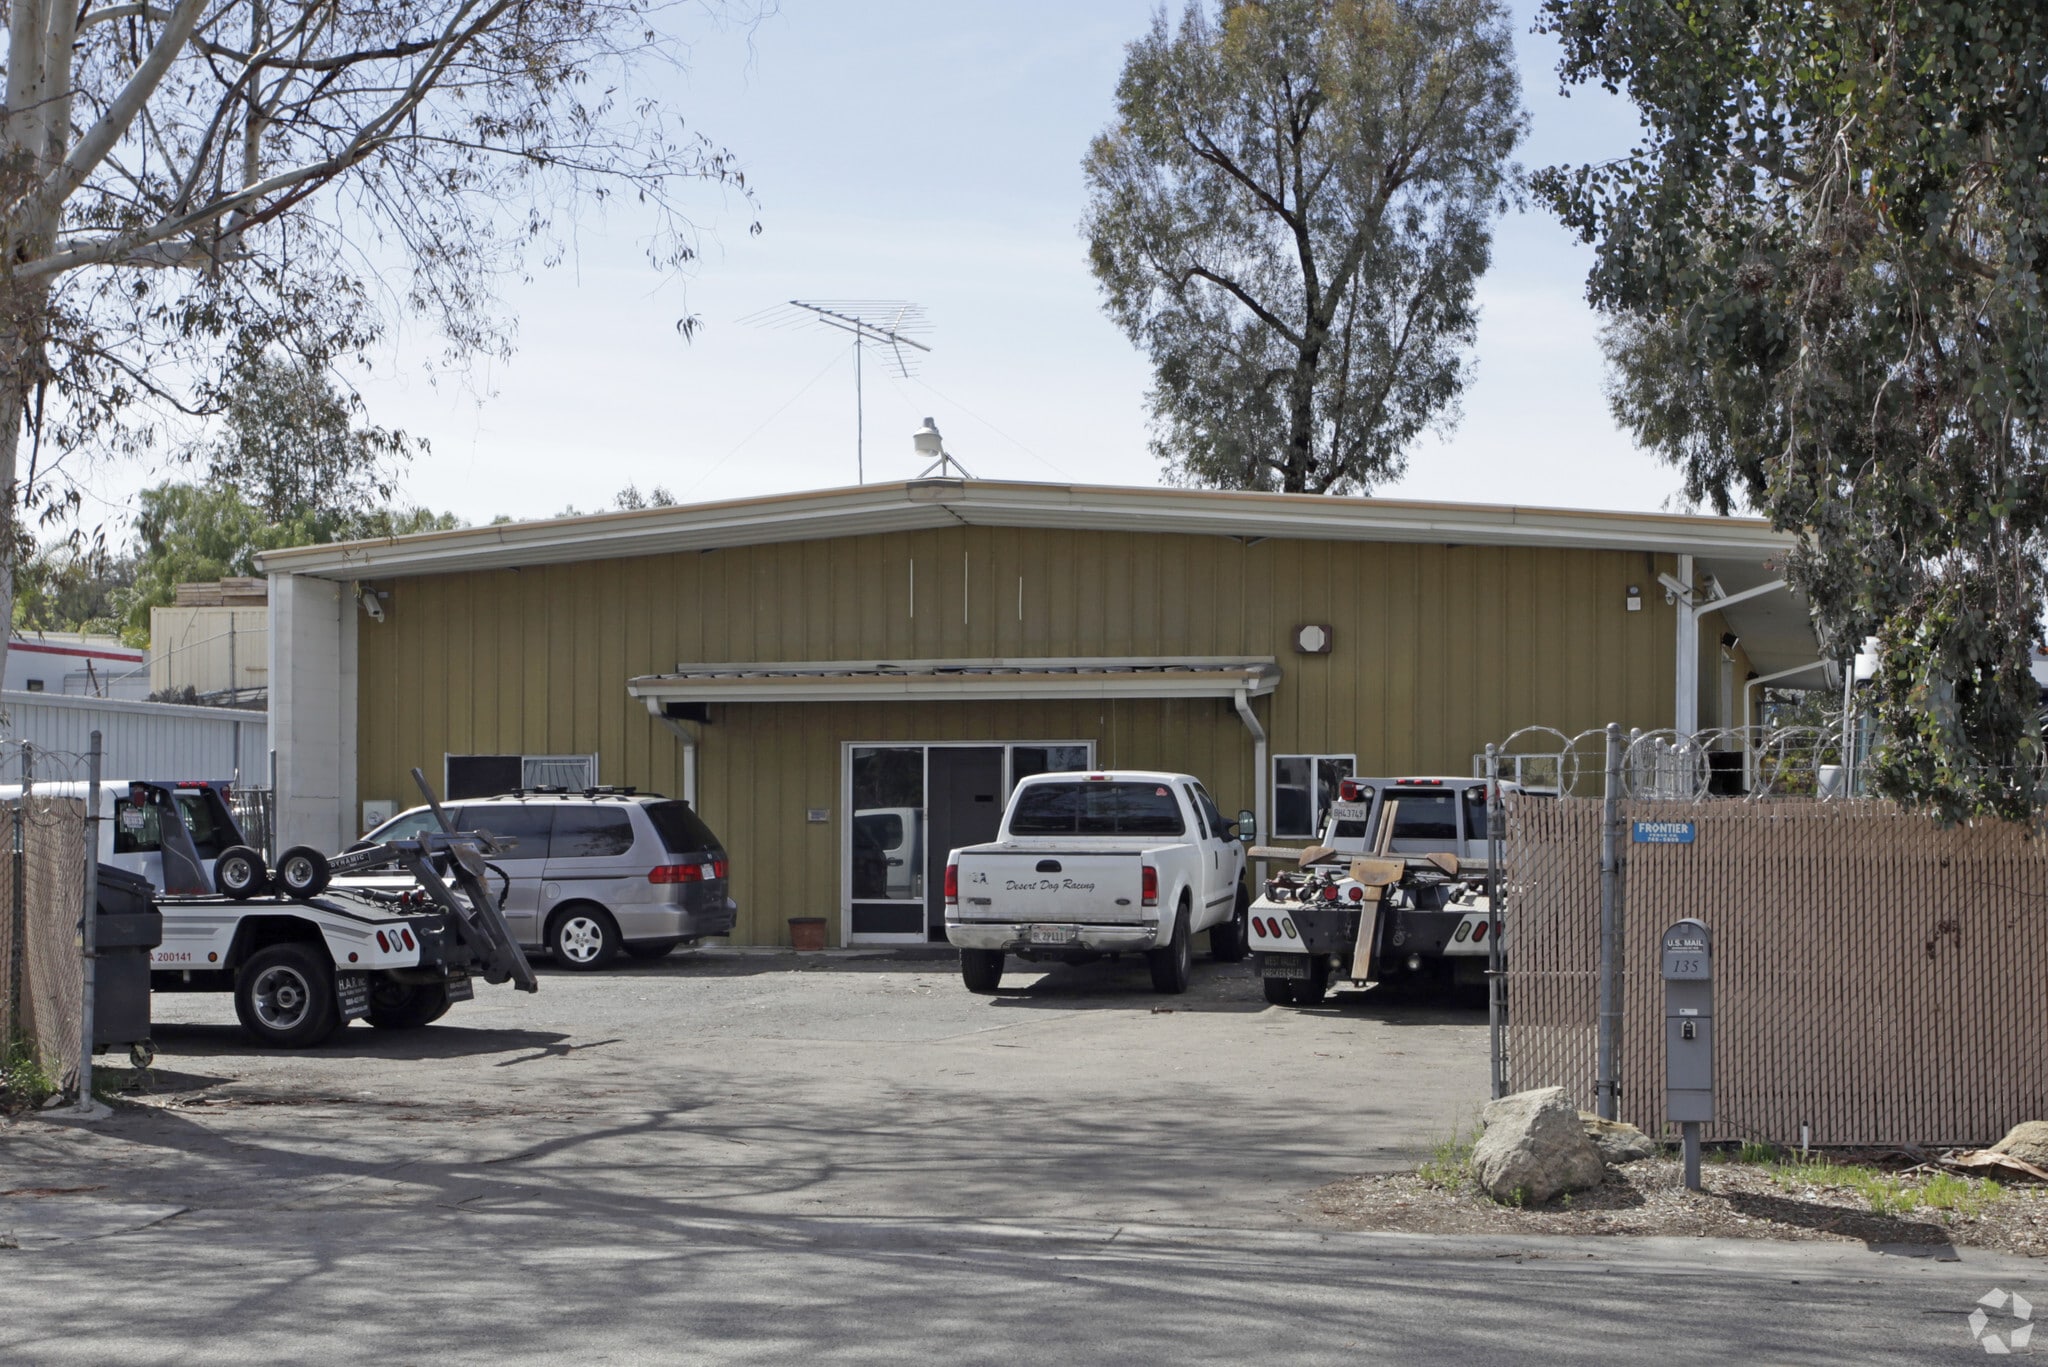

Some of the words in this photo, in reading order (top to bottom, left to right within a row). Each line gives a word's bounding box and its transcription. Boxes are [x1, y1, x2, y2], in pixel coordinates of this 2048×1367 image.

[1638, 822, 1688, 834] FRONTIER
[330, 853, 364, 868] DYNAMIC
[1006, 880, 1037, 891] Desert
[1040, 879, 1060, 893] Dog
[1063, 878, 1096, 893] Racing
[1667, 939, 1683, 947] U.S.
[1684, 939, 1704, 947] MAIL
[157, 952, 192, 962] 200141
[1673, 960, 1698, 973] 135
